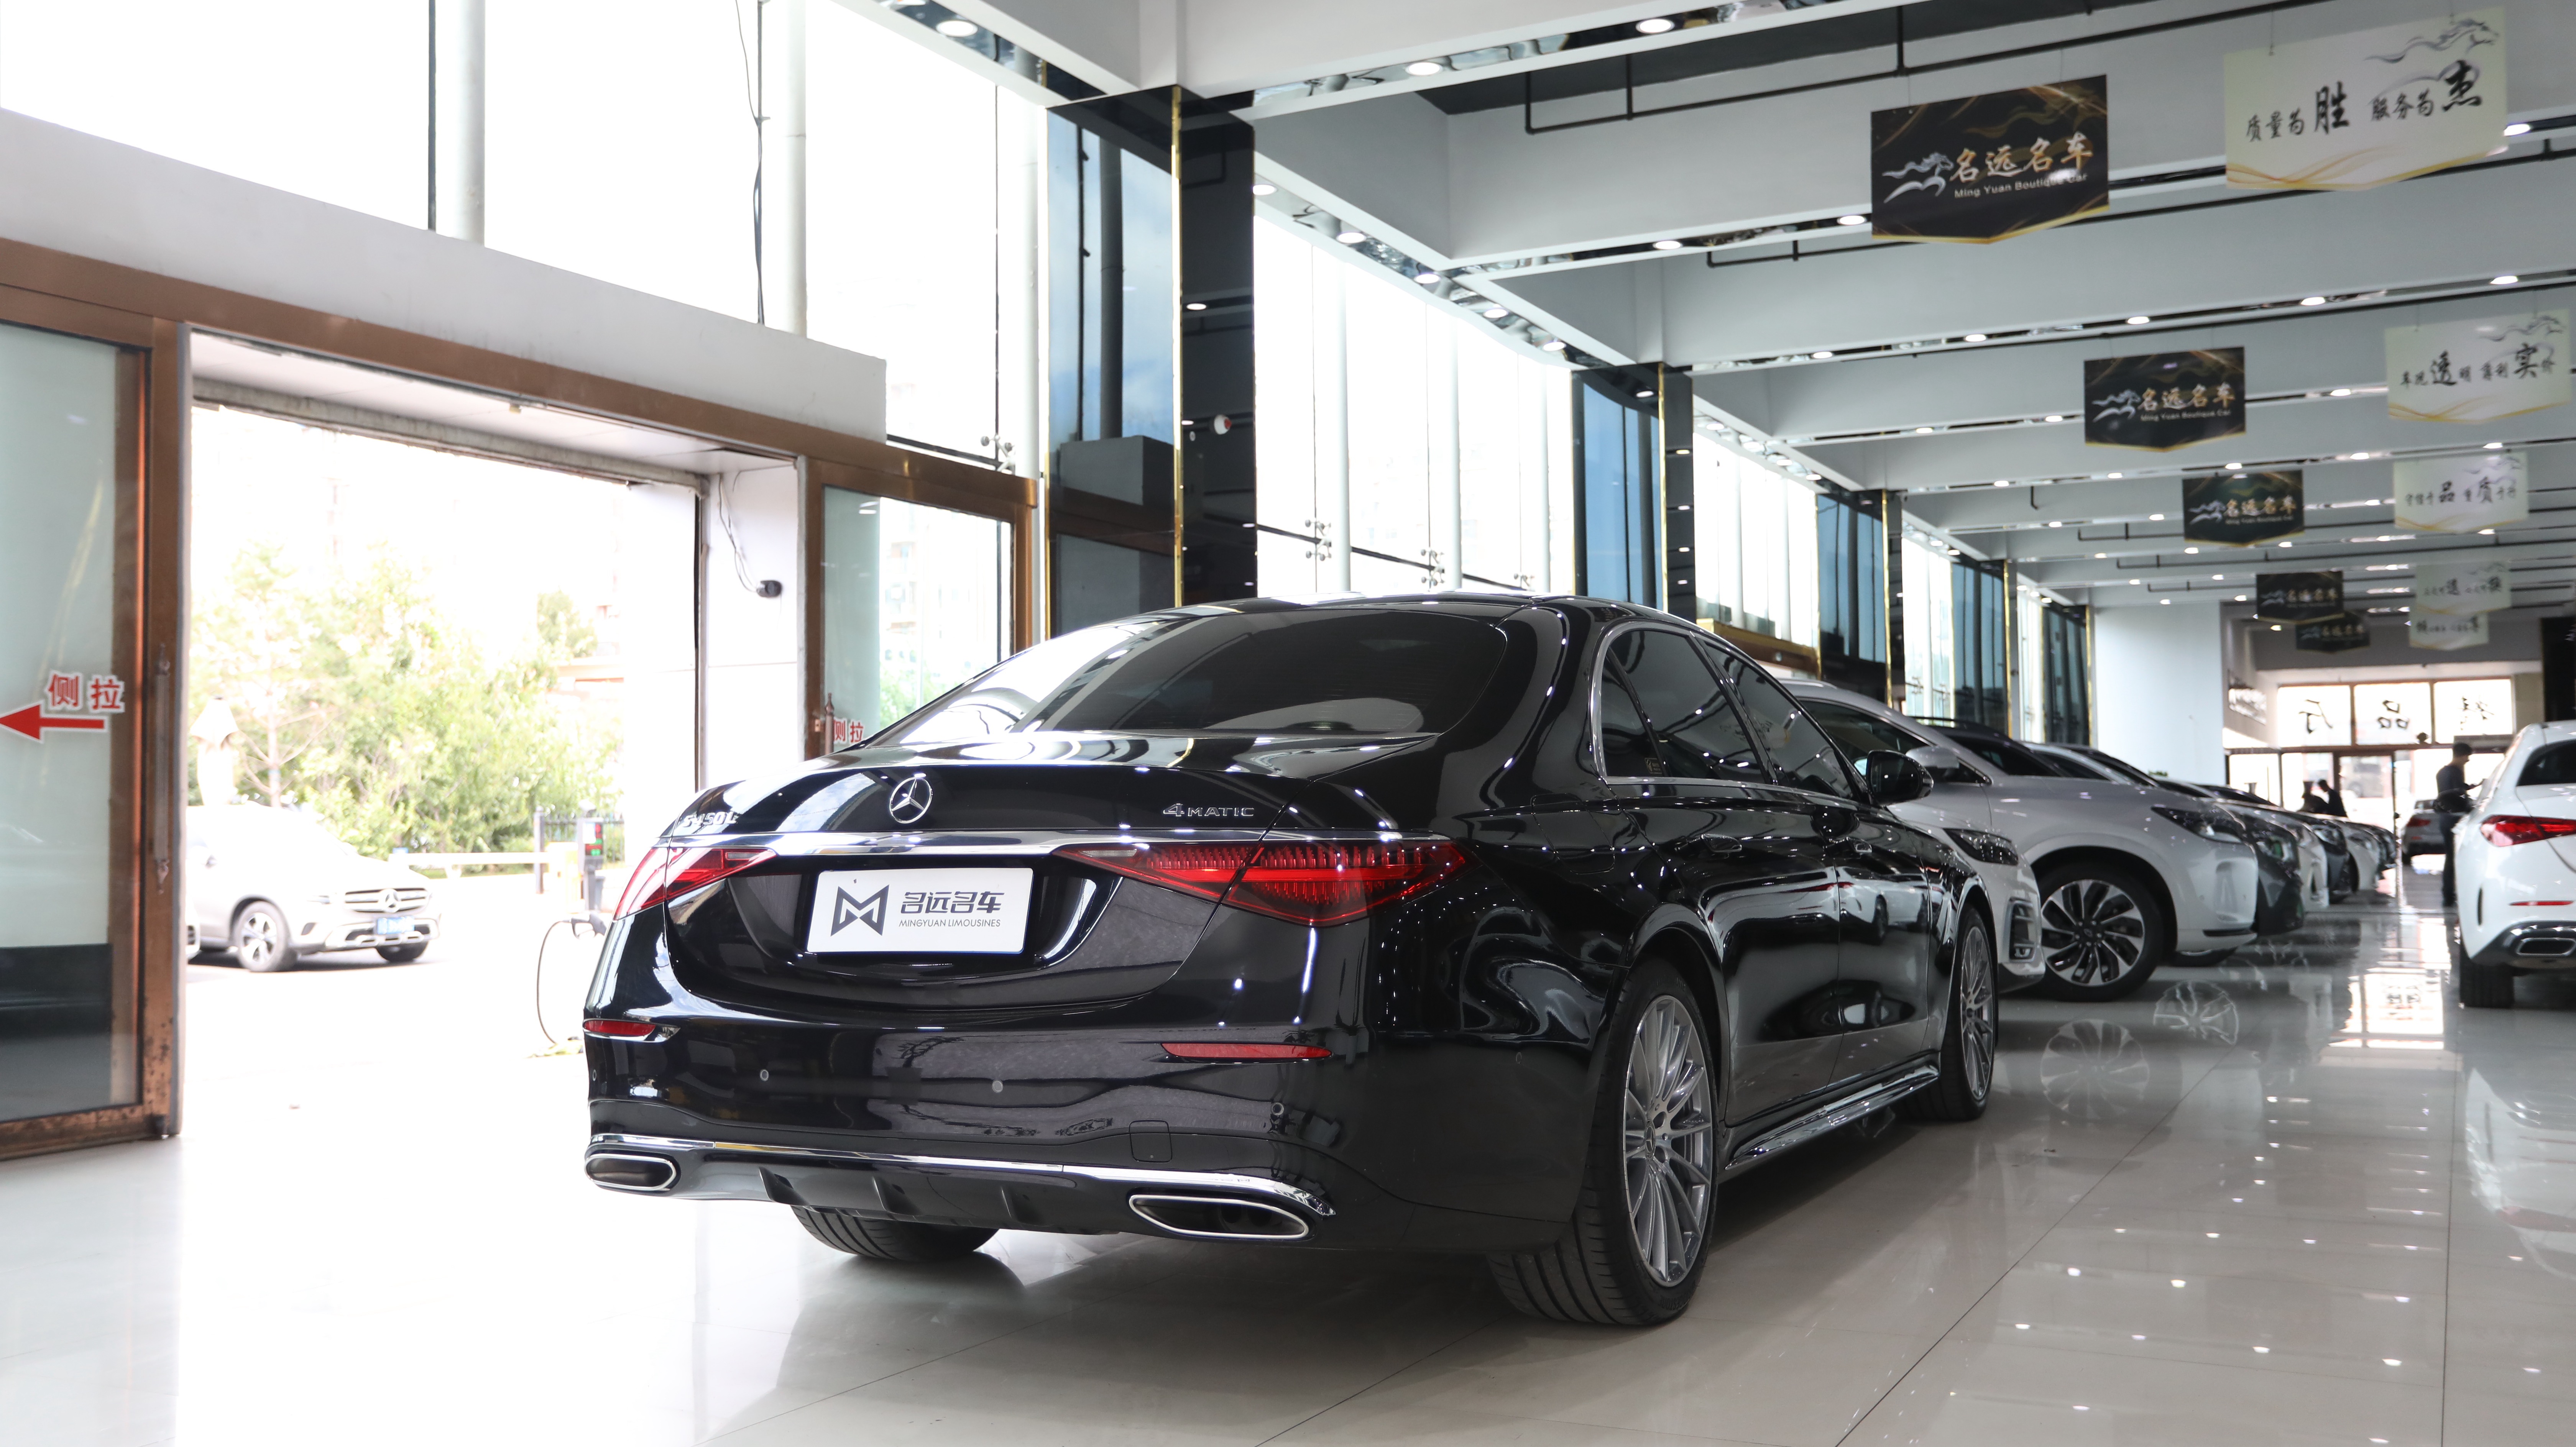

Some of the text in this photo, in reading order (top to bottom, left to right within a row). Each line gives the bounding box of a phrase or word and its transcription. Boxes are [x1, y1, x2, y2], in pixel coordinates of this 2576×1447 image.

[2246, 60, 2482, 141] 质量为胜 服务为杰
[1950, 131, 2093, 184] 名远名车
[1954, 189, 1981, 198] Ming
[1983, 183, 2012, 194] Yuan
[2015, 177, 2064, 191] Boutiq
[2138, 382, 2235, 411] 名远名车
[48, 674, 121, 710] 侧拉
[1163, 803, 1255, 817] 4MATIC
[901, 891, 1005, 914] 名远名车
[899, 919, 1001, 927] MINGYUAN LIMOUSINES
